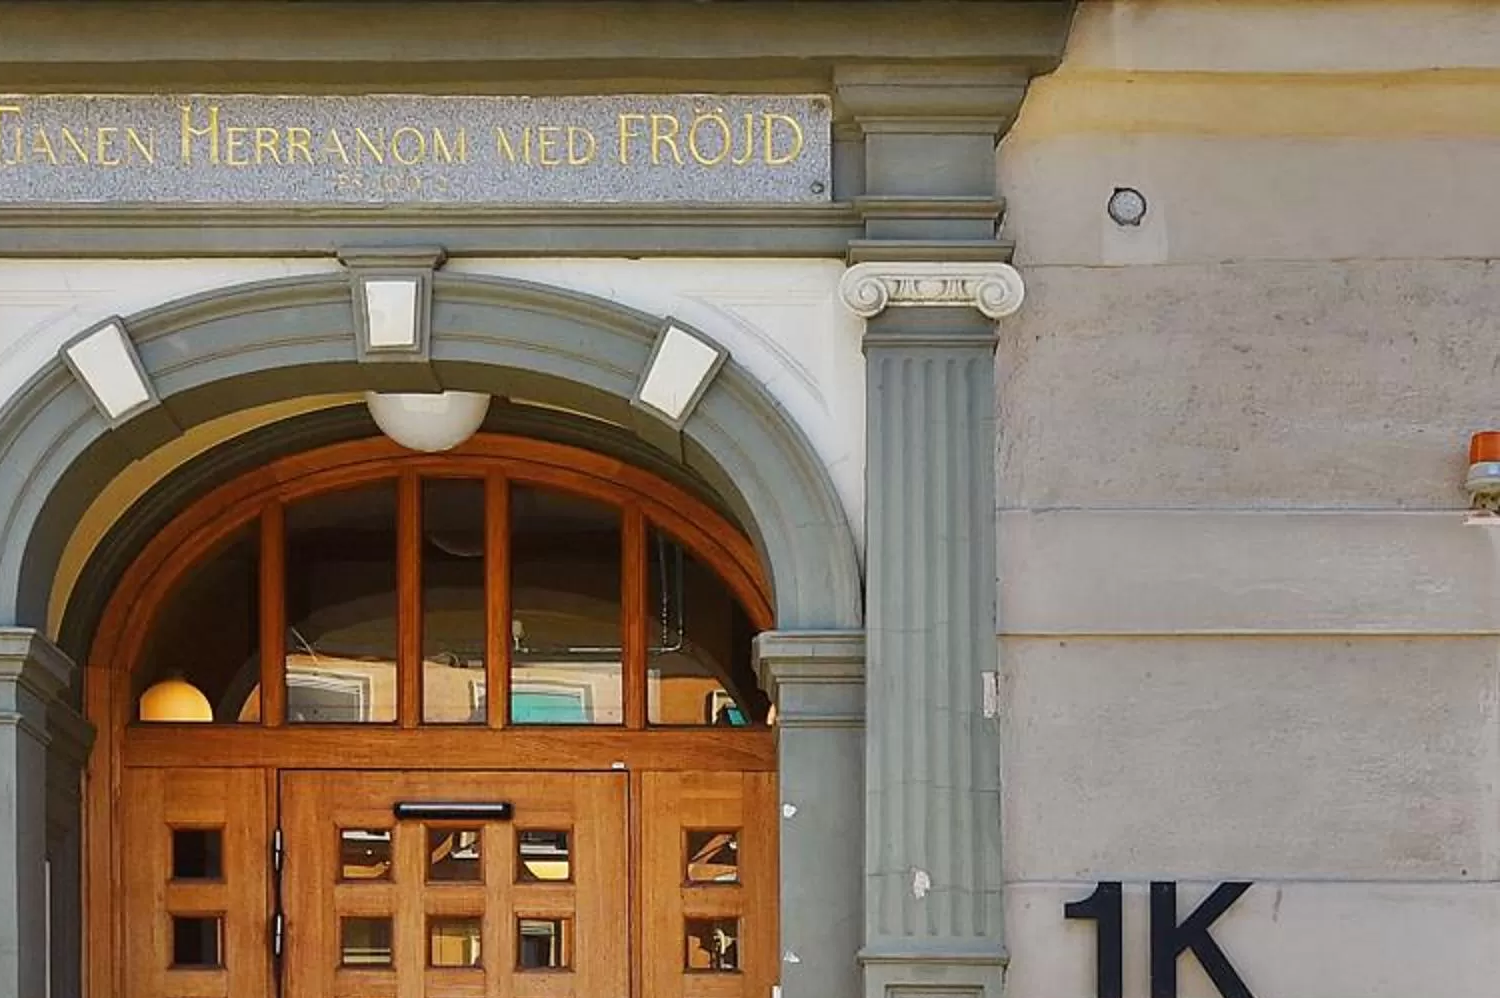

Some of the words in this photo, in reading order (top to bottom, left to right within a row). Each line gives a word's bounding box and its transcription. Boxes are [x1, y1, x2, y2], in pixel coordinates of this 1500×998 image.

[180, 104, 469, 166] HERRANOM
[495, 126, 598, 166] MED
[618, 106, 804, 166] FRÖJD
